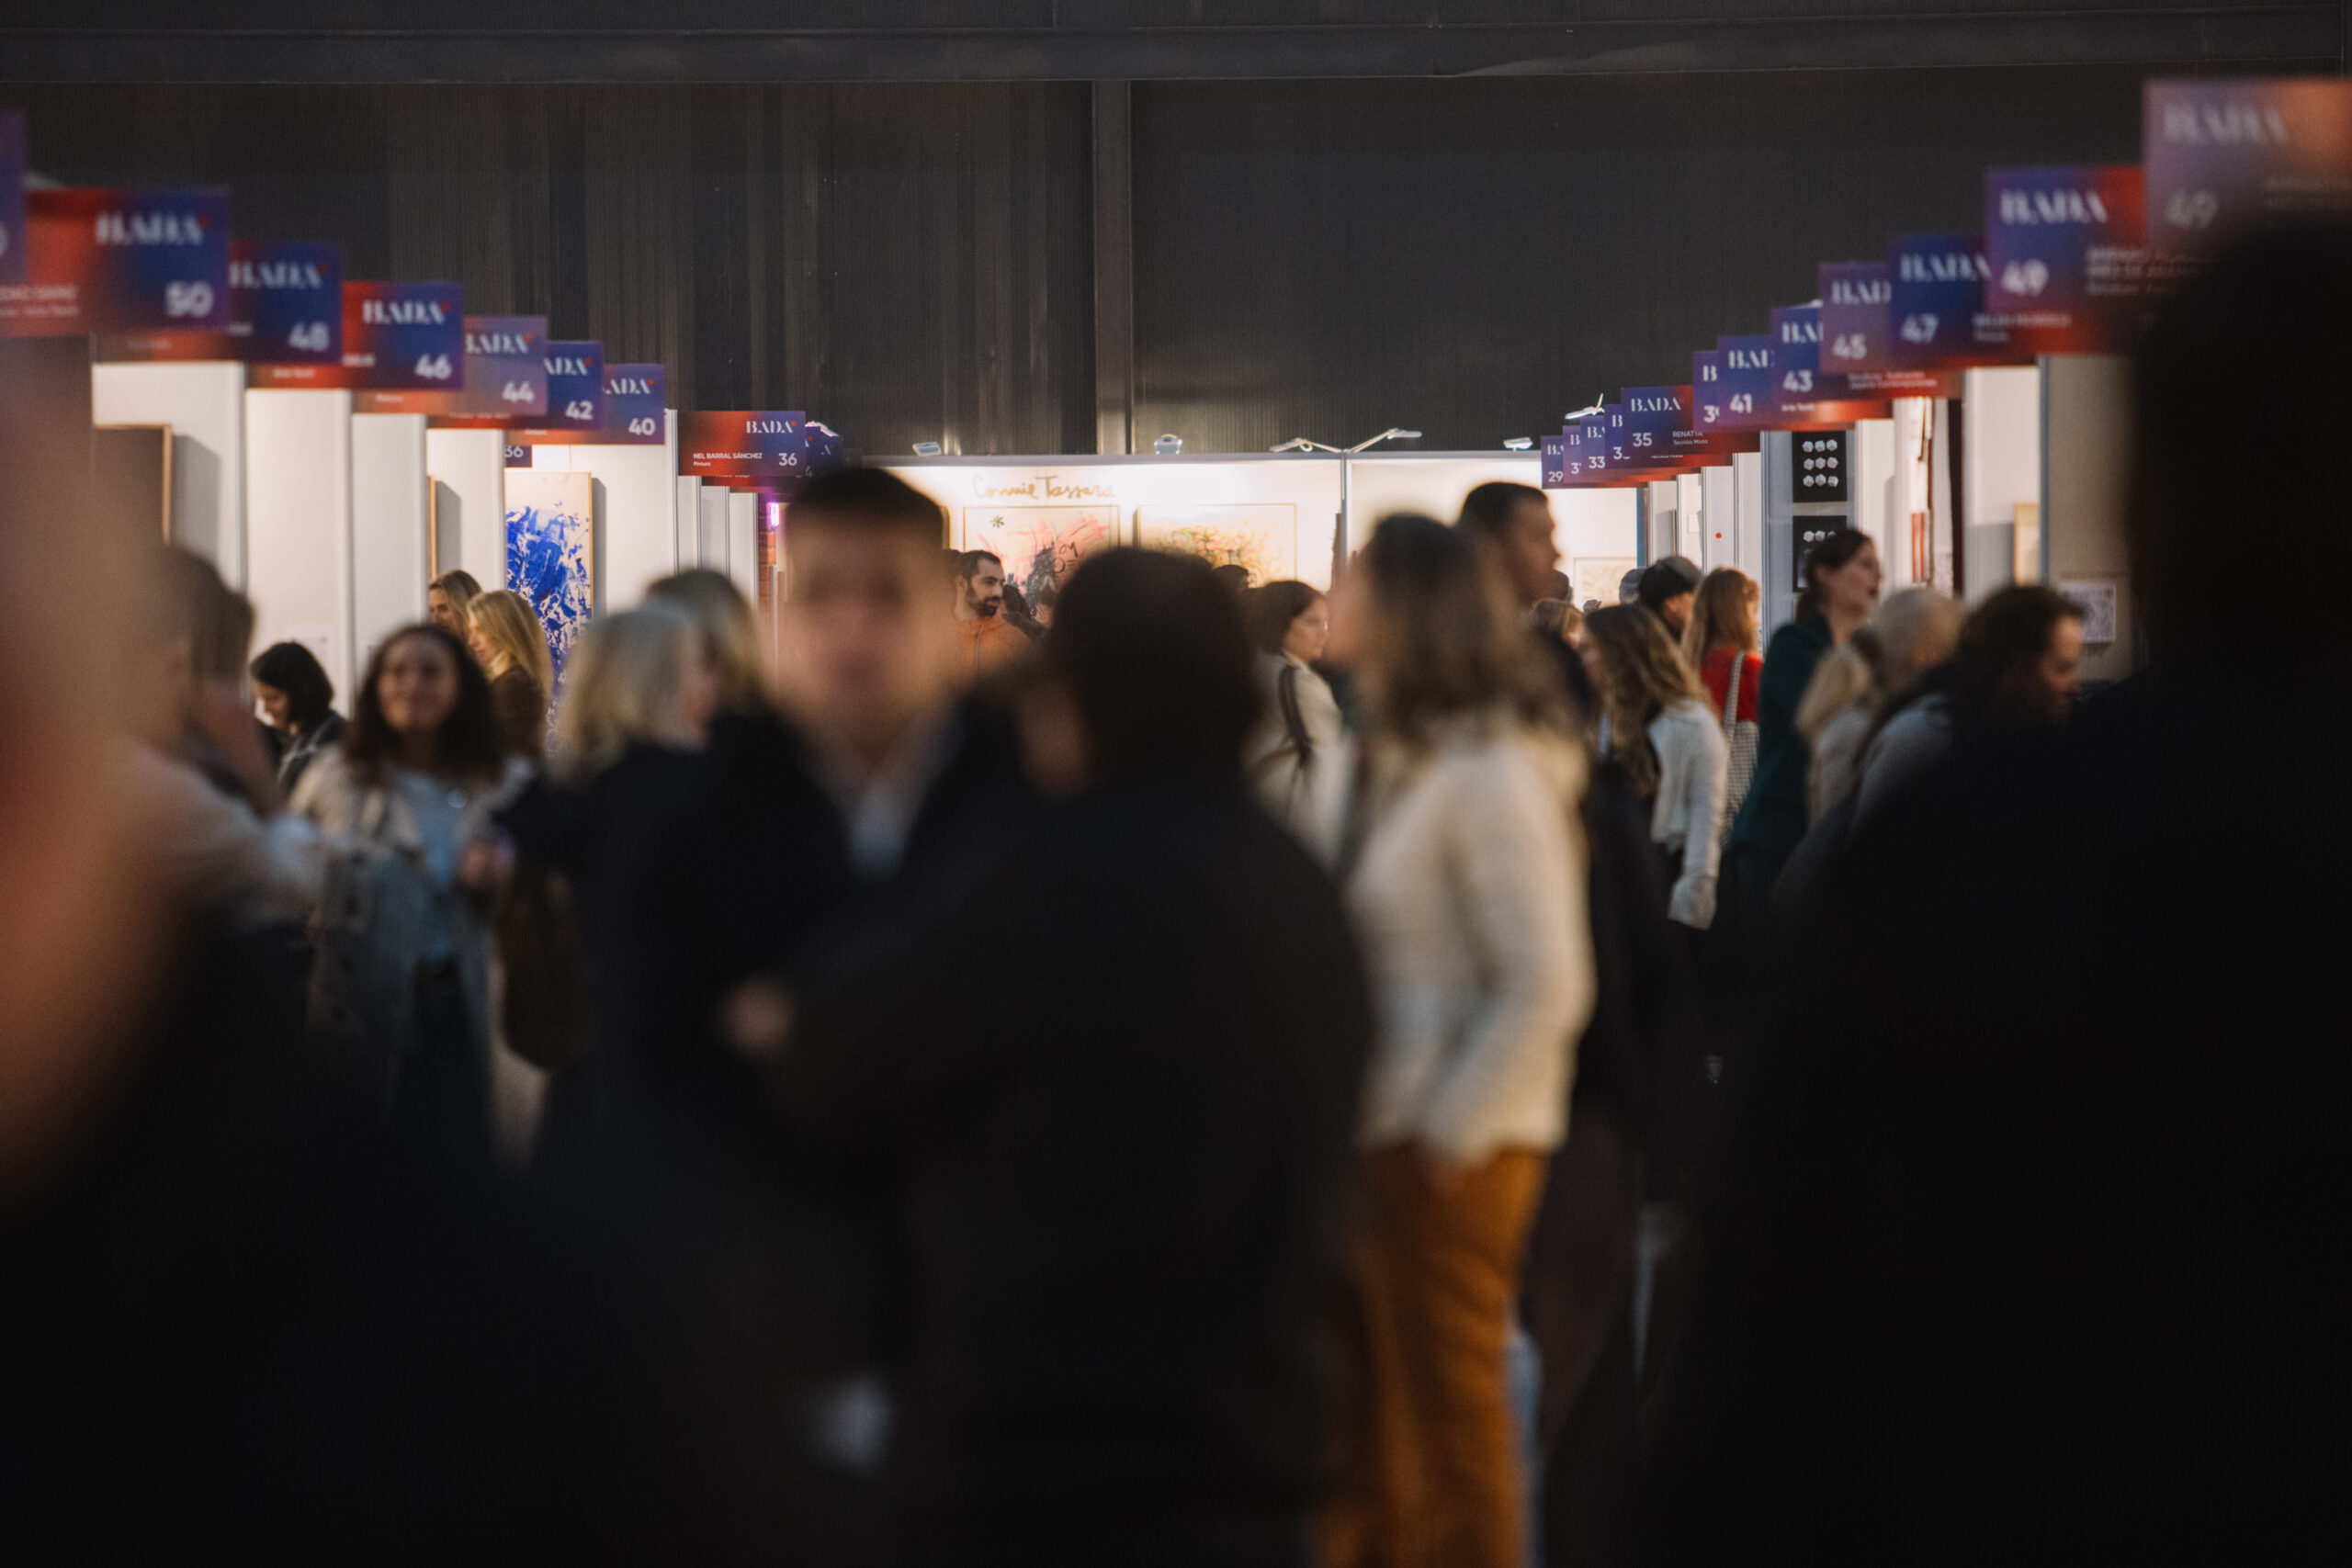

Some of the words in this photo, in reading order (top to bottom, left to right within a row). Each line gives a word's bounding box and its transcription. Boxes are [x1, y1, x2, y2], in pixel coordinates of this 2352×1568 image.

[2001, 259, 2049, 296] 49
[363, 300, 445, 324] BADA
[288, 323, 330, 351] 48
[1901, 313, 1939, 343] 47
[1833, 334, 1867, 359] 45
[415, 354, 452, 380] 46
[1783, 369, 1813, 392] 43
[502, 381, 535, 402] 44
[565, 401, 593, 420] 42
[1631, 397, 1681, 412] BADA
[1729, 393, 1752, 412] 41
[628, 418, 656, 435] 40
[746, 421, 794, 434] BADA
[1633, 433, 1653, 447] 35
[732, 451, 763, 459] SÁNCHEZ
[778, 453, 797, 467] 36
[1589, 456, 1606, 468] 33
[1548, 470, 1564, 482] 29
[1034, 475, 1115, 499] Tassara
